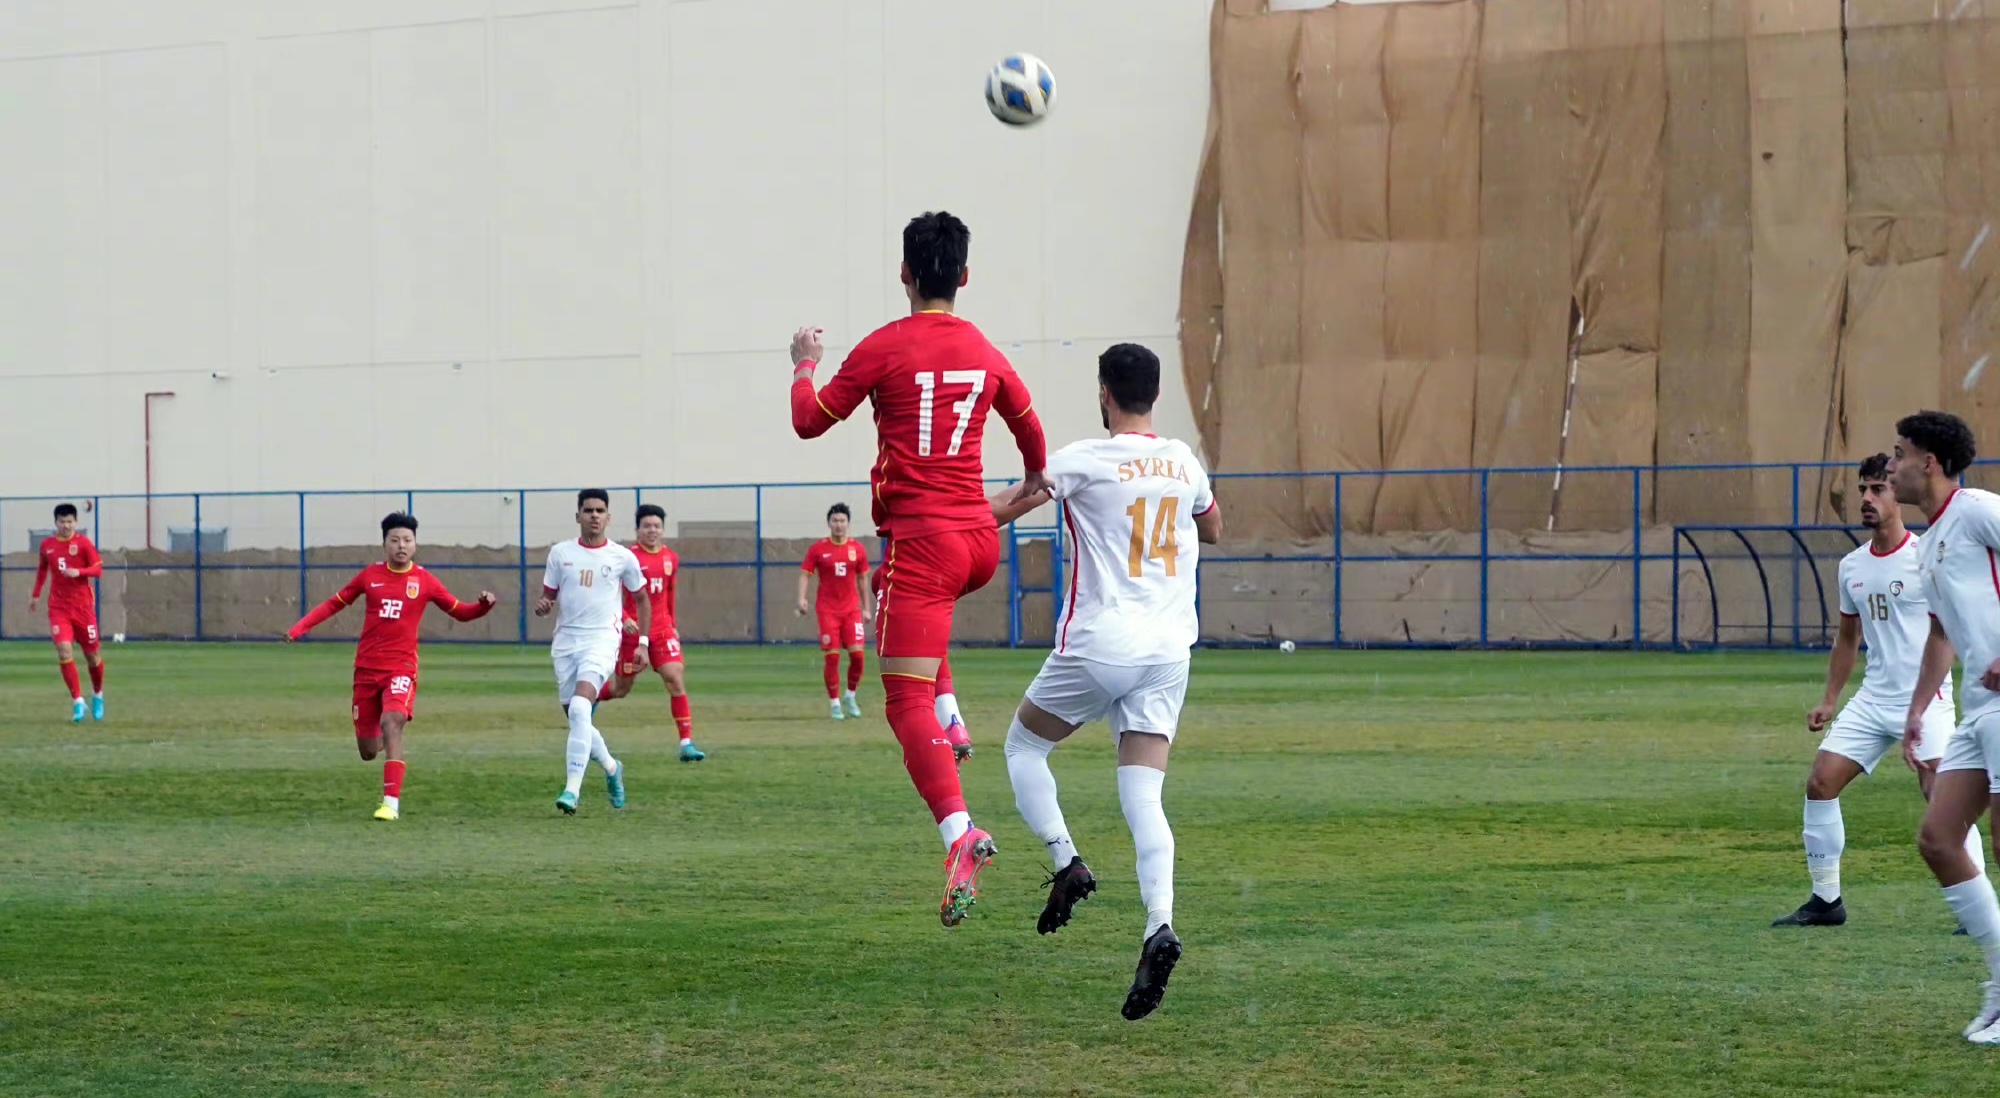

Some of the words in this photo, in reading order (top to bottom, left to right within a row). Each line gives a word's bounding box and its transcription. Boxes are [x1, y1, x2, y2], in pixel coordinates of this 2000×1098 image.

[915, 370, 986, 456] 17
[1118, 457, 1190, 485] SYRIA
[1126, 496, 1179, 577] 14
[58, 557, 66, 571] 5
[834, 562, 847, 576] 15
[580, 570, 593, 588] 10
[650, 577, 663, 594] 14
[379, 599, 403, 619] 32
[1868, 593, 1888, 621] 16
[87, 625, 96, 639] 5
[390, 676, 411, 691] 32
